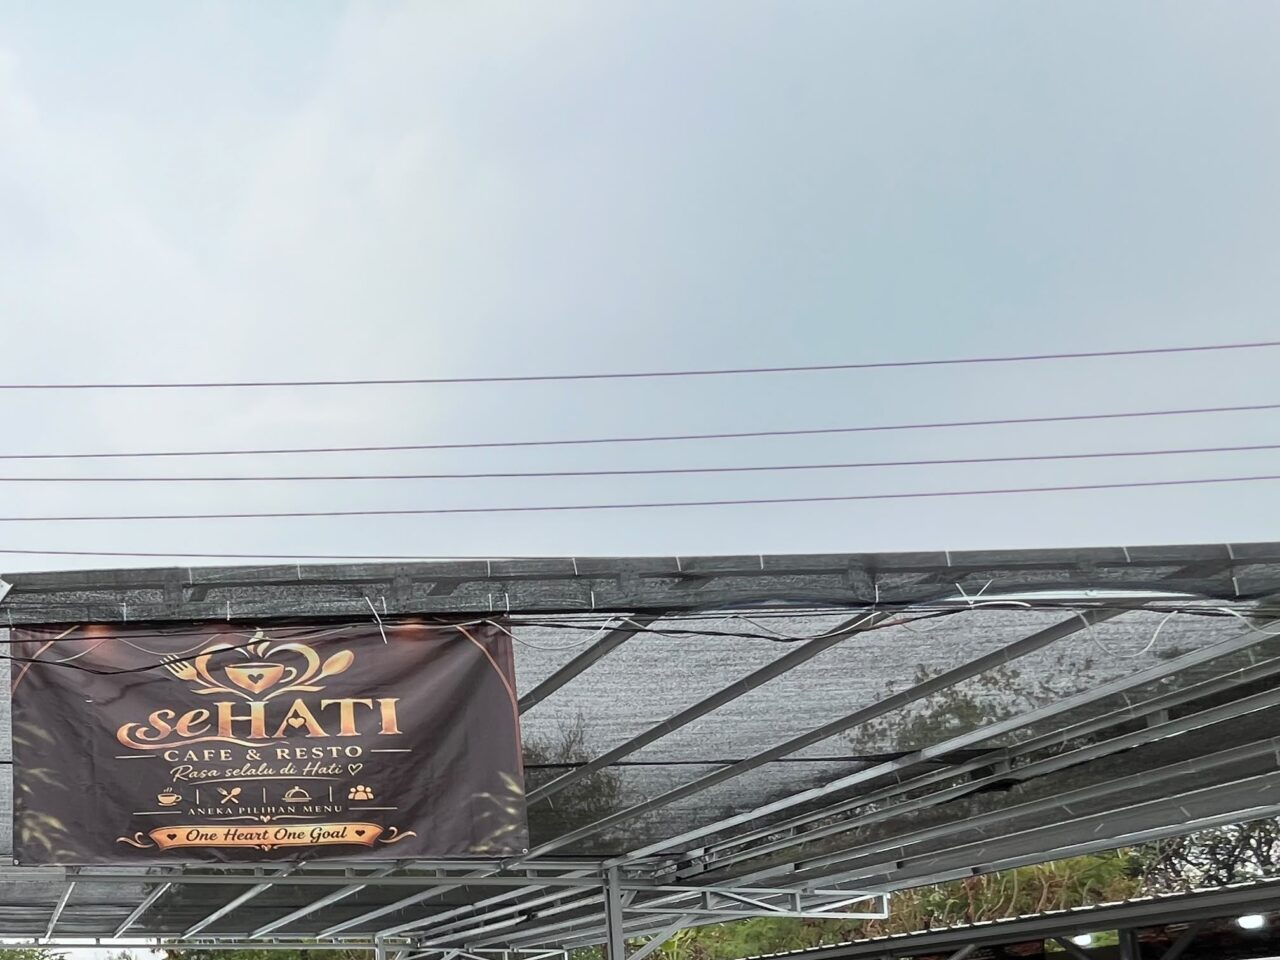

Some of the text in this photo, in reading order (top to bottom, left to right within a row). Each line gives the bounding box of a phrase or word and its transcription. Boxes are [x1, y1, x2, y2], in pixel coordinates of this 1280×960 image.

[163, 745, 363, 762] CAFE & RESTO
[170, 762, 344, 783] Rasa selalu di Hati
[188, 805, 342, 816] ANEKA PILIHAN MENU
[186, 827, 348, 843] One Heart One Goal
